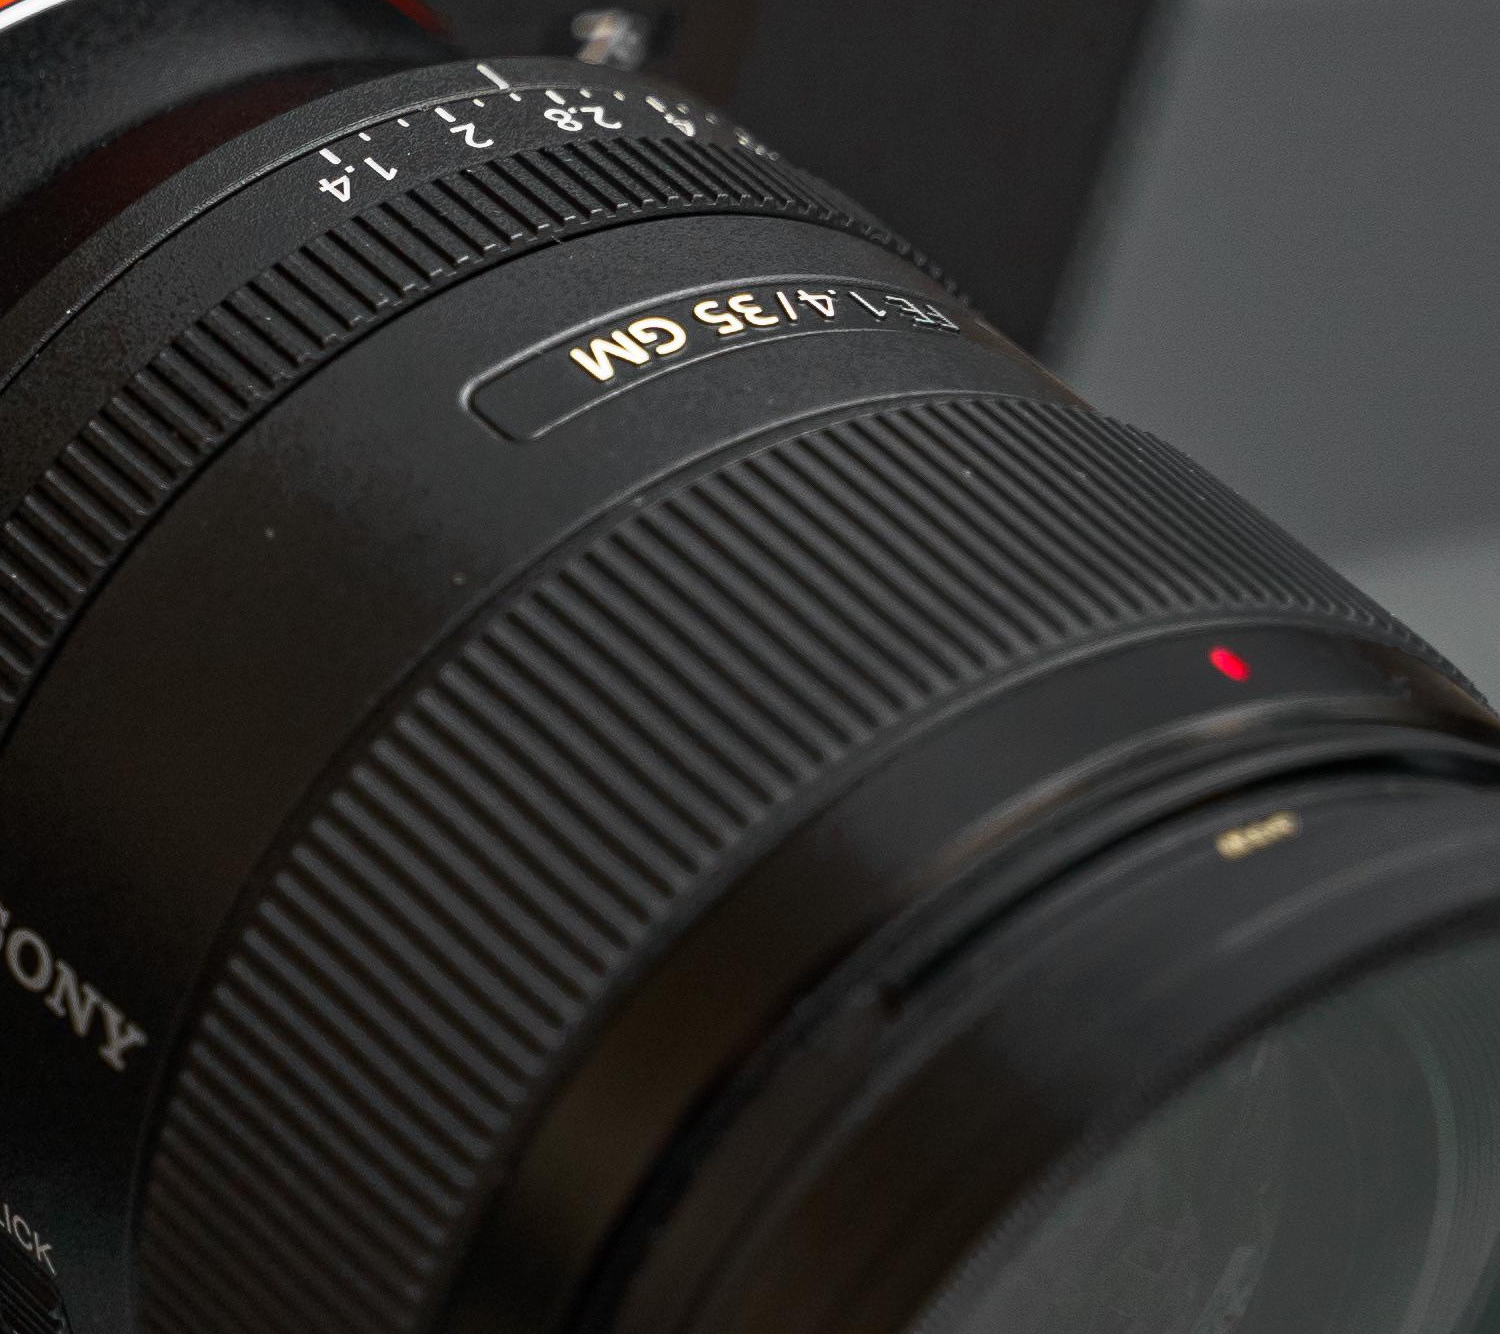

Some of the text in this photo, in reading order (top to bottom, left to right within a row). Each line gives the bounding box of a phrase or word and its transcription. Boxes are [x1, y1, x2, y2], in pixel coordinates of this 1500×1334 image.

[449, 122, 495, 149] 2
[542, 105, 623, 132] 2.8
[318, 157, 399, 203] 1.4
[692, 289, 888, 337] 1.4/35
[568, 316, 689, 382] GM
